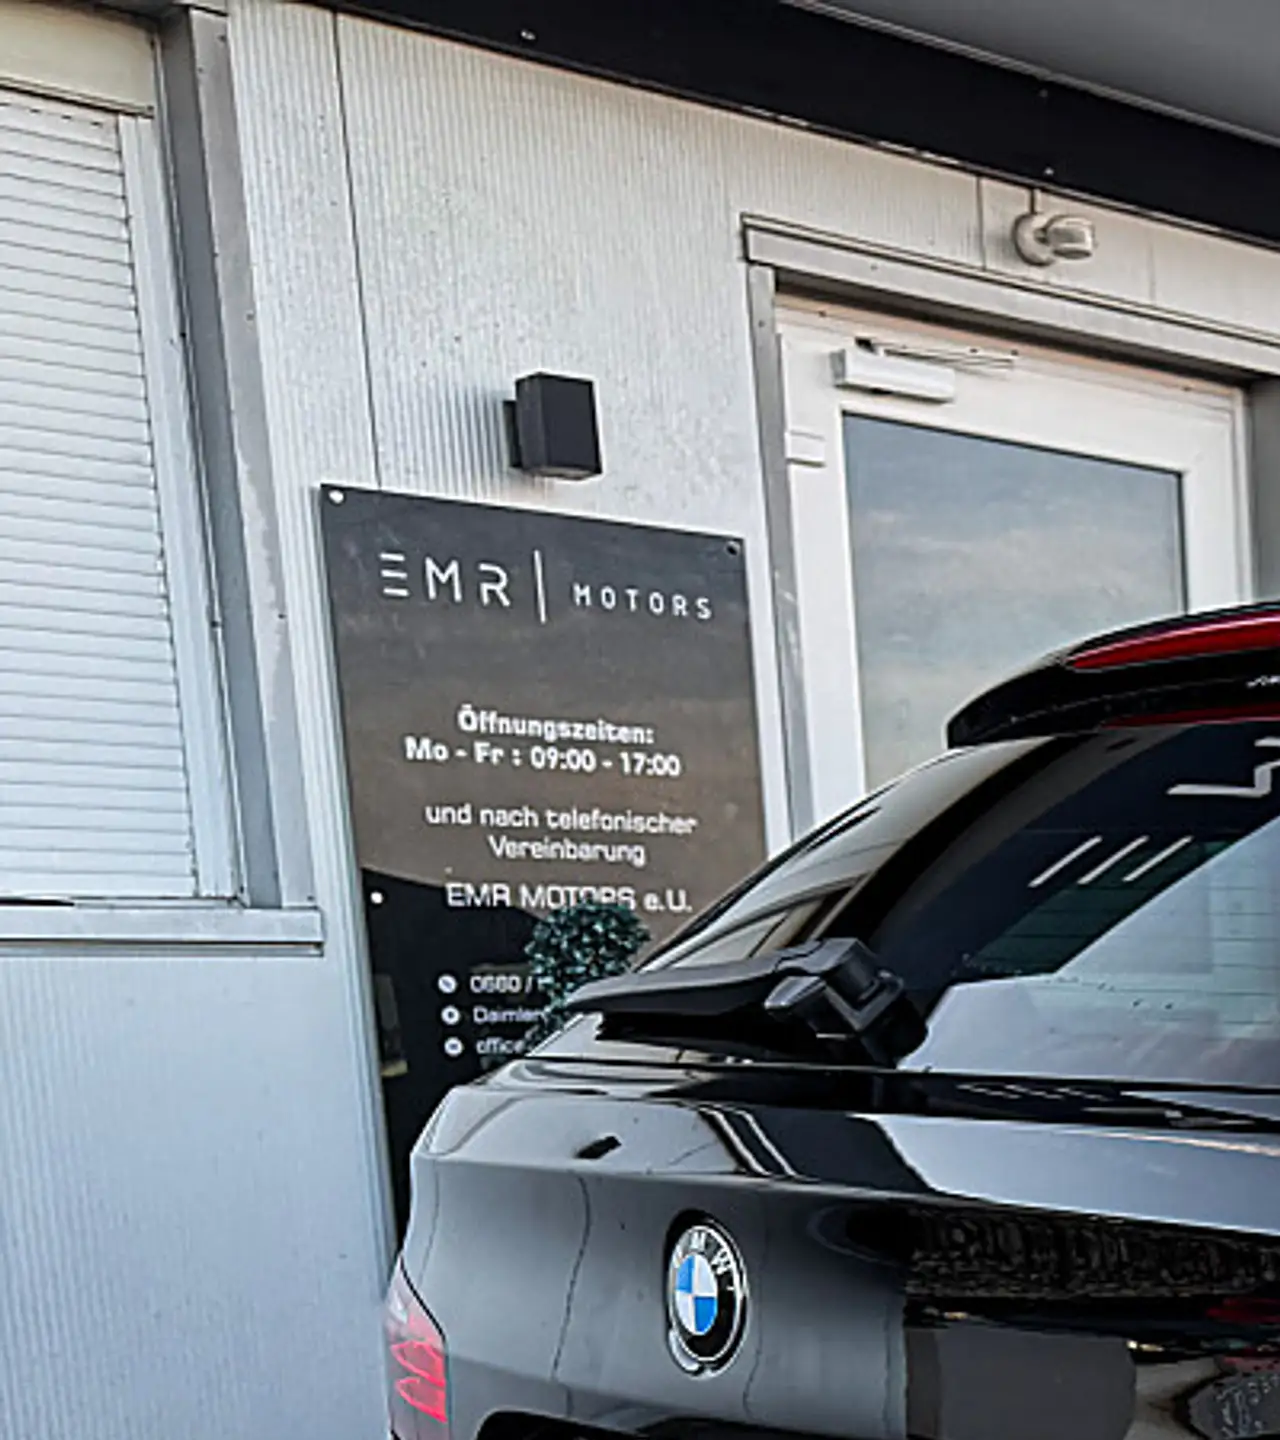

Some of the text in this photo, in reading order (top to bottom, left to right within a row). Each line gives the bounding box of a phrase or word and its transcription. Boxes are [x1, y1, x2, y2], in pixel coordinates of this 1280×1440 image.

[379, 551, 712, 620] EMR MOTORS
[457, 703, 655, 744] Öffnungszeiten:
[405, 736, 449, 762] Mo
[474, 741, 503, 766] Fr
[530, 746, 596, 773] 09:00
[619, 751, 681, 777] 17:00
[425, 804, 698, 834] und nach telefonischer
[488, 834, 646, 867] Vereinbarung
[446, 882, 512, 908] EMR
